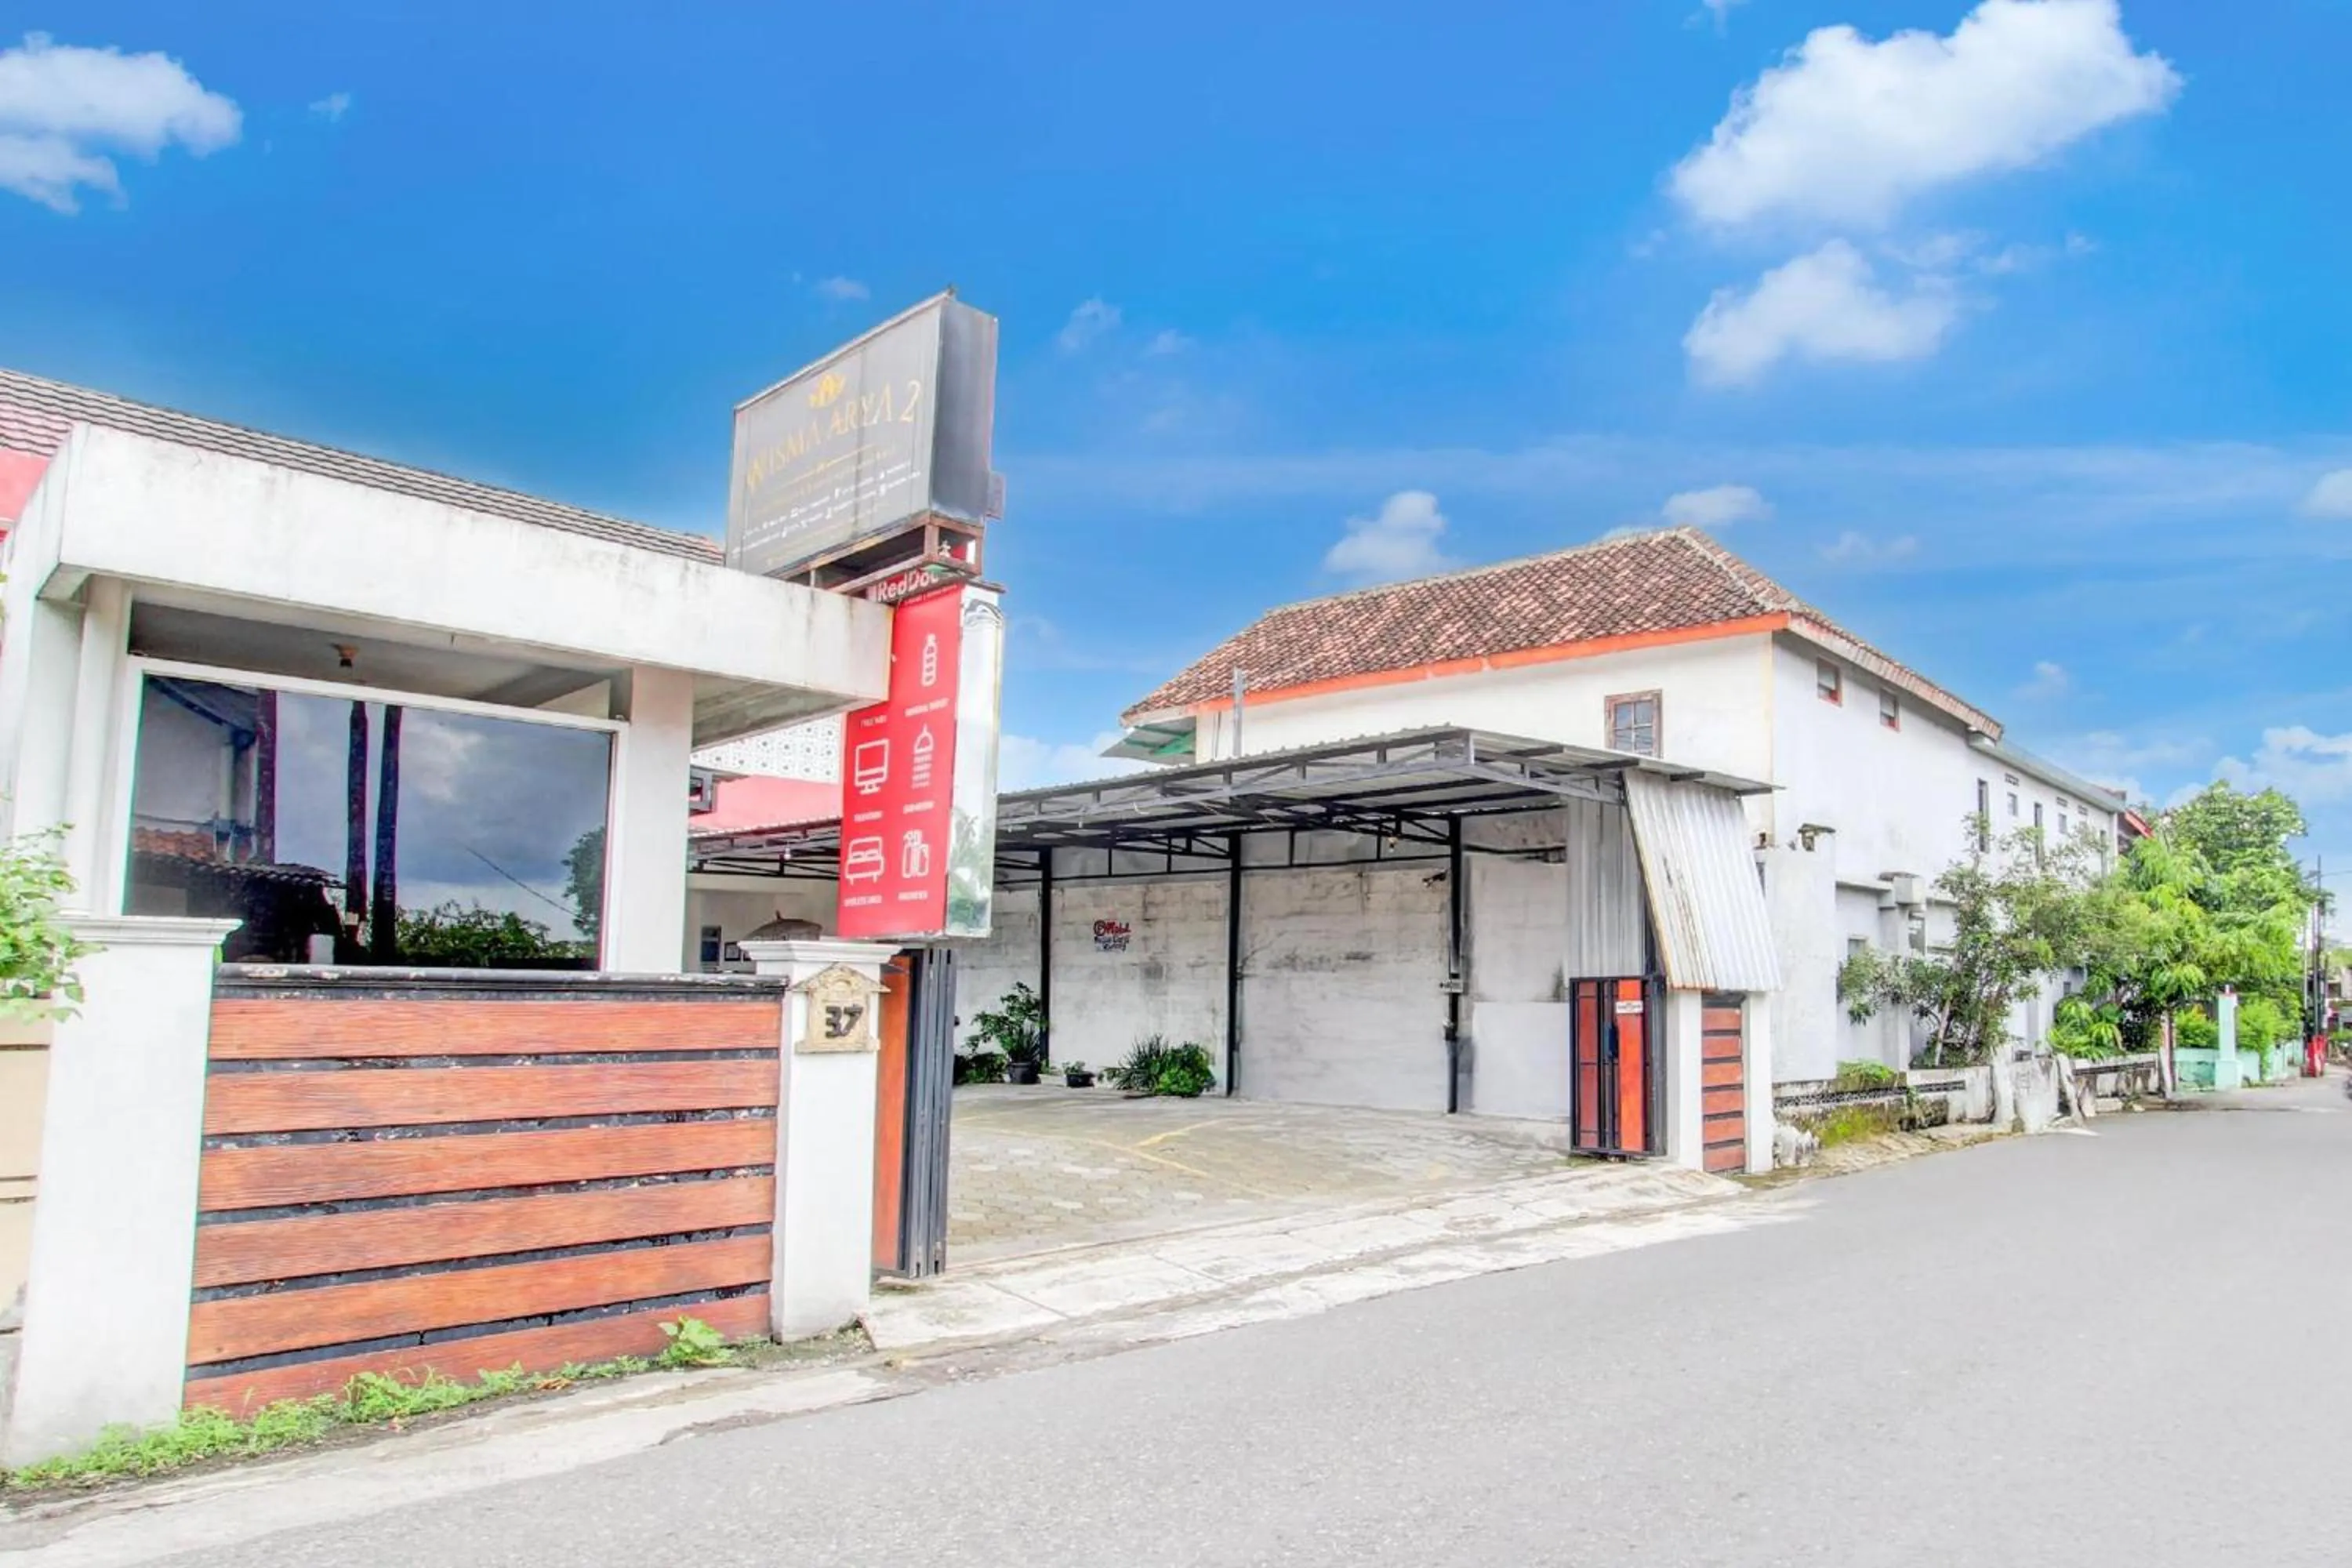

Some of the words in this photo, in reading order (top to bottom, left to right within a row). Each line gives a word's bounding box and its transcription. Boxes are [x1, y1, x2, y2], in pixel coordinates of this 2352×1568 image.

[747, 420, 821, 495] WISMA
[829, 383, 892, 435] ARYA
[899, 380, 920, 423] 2
[825, 1004, 863, 1038] 37
